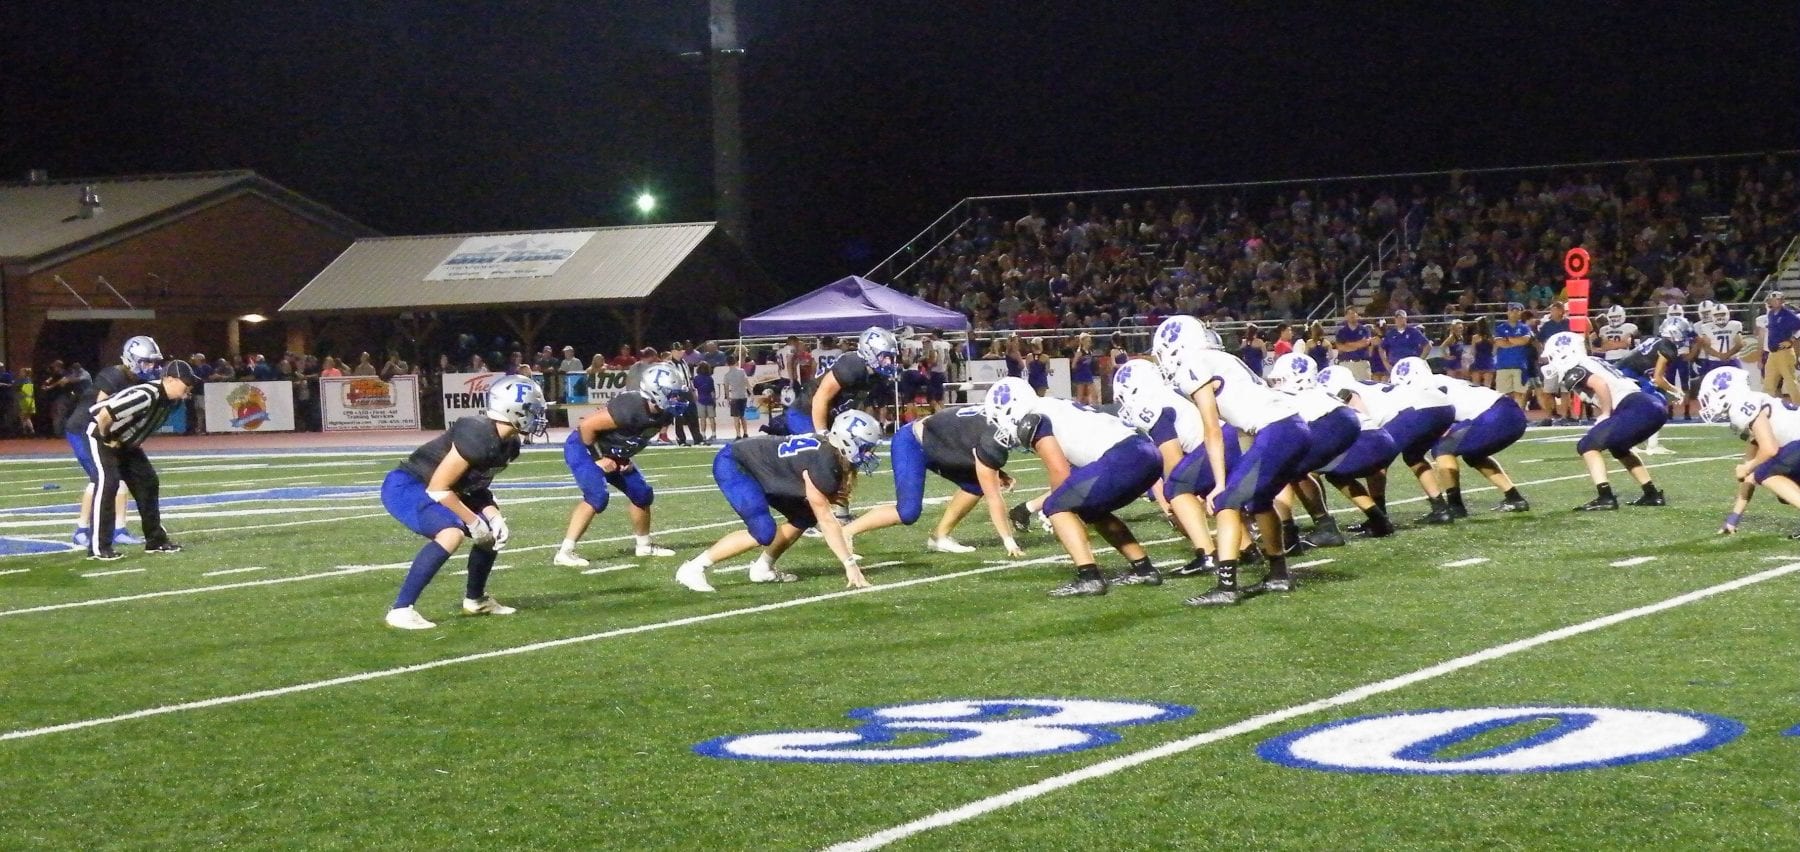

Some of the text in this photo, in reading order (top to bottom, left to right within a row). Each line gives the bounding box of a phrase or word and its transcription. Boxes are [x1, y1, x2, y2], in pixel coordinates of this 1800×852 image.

[1717, 335, 1729, 353] 71
[464, 374, 493, 394] The
[515, 383, 532, 403] F
[1139, 409, 1155, 424] 65
[1740, 401, 1757, 417] 26
